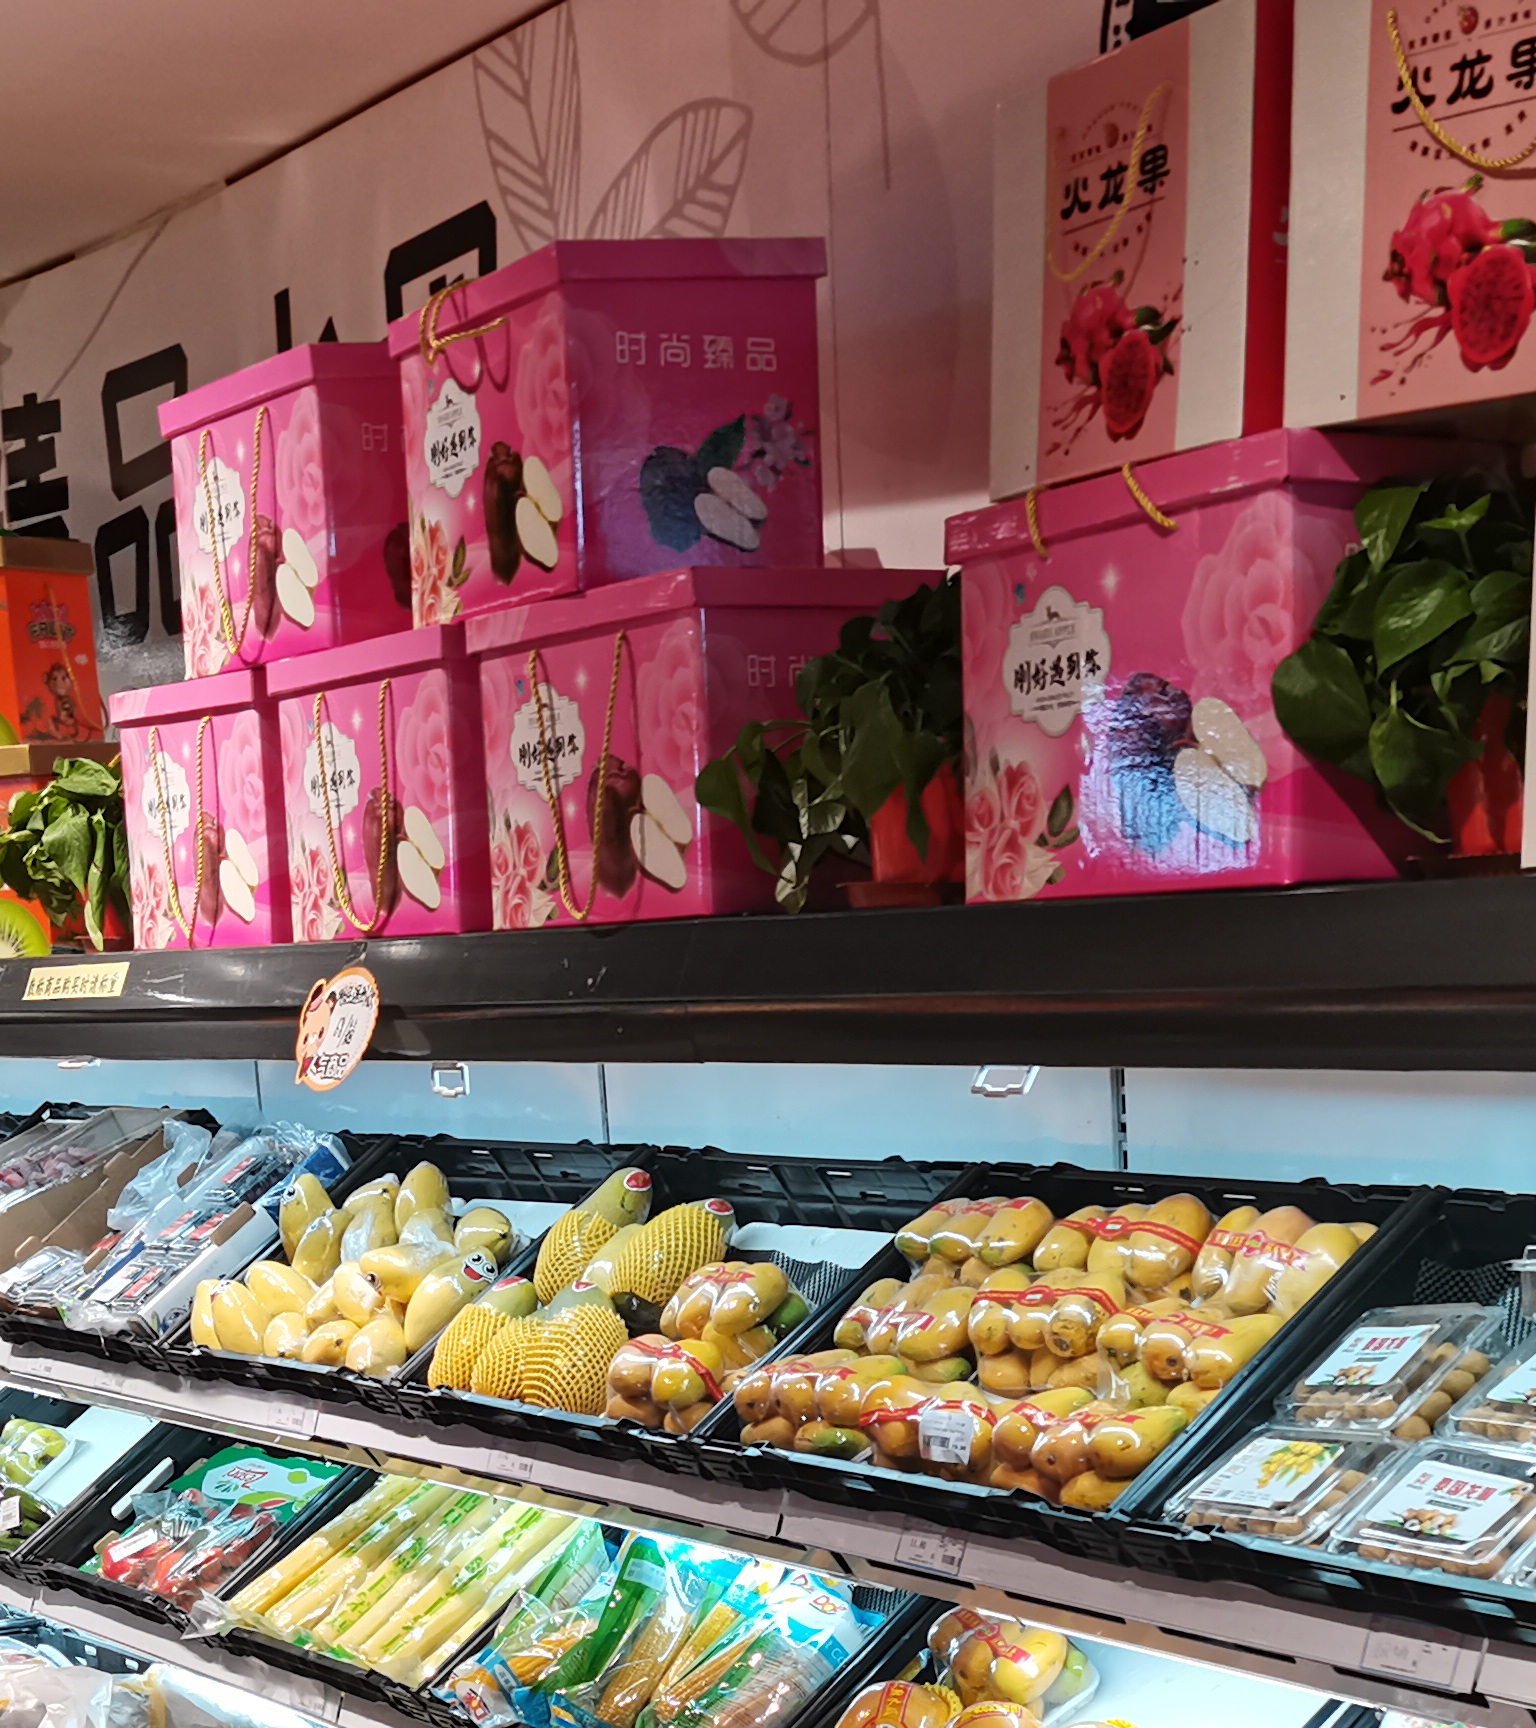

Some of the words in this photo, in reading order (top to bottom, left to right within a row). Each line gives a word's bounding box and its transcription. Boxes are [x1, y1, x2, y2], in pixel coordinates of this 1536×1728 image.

[1060, 143, 1170, 220] 火龙果
[614, 331, 777, 372] 时尚臻品
